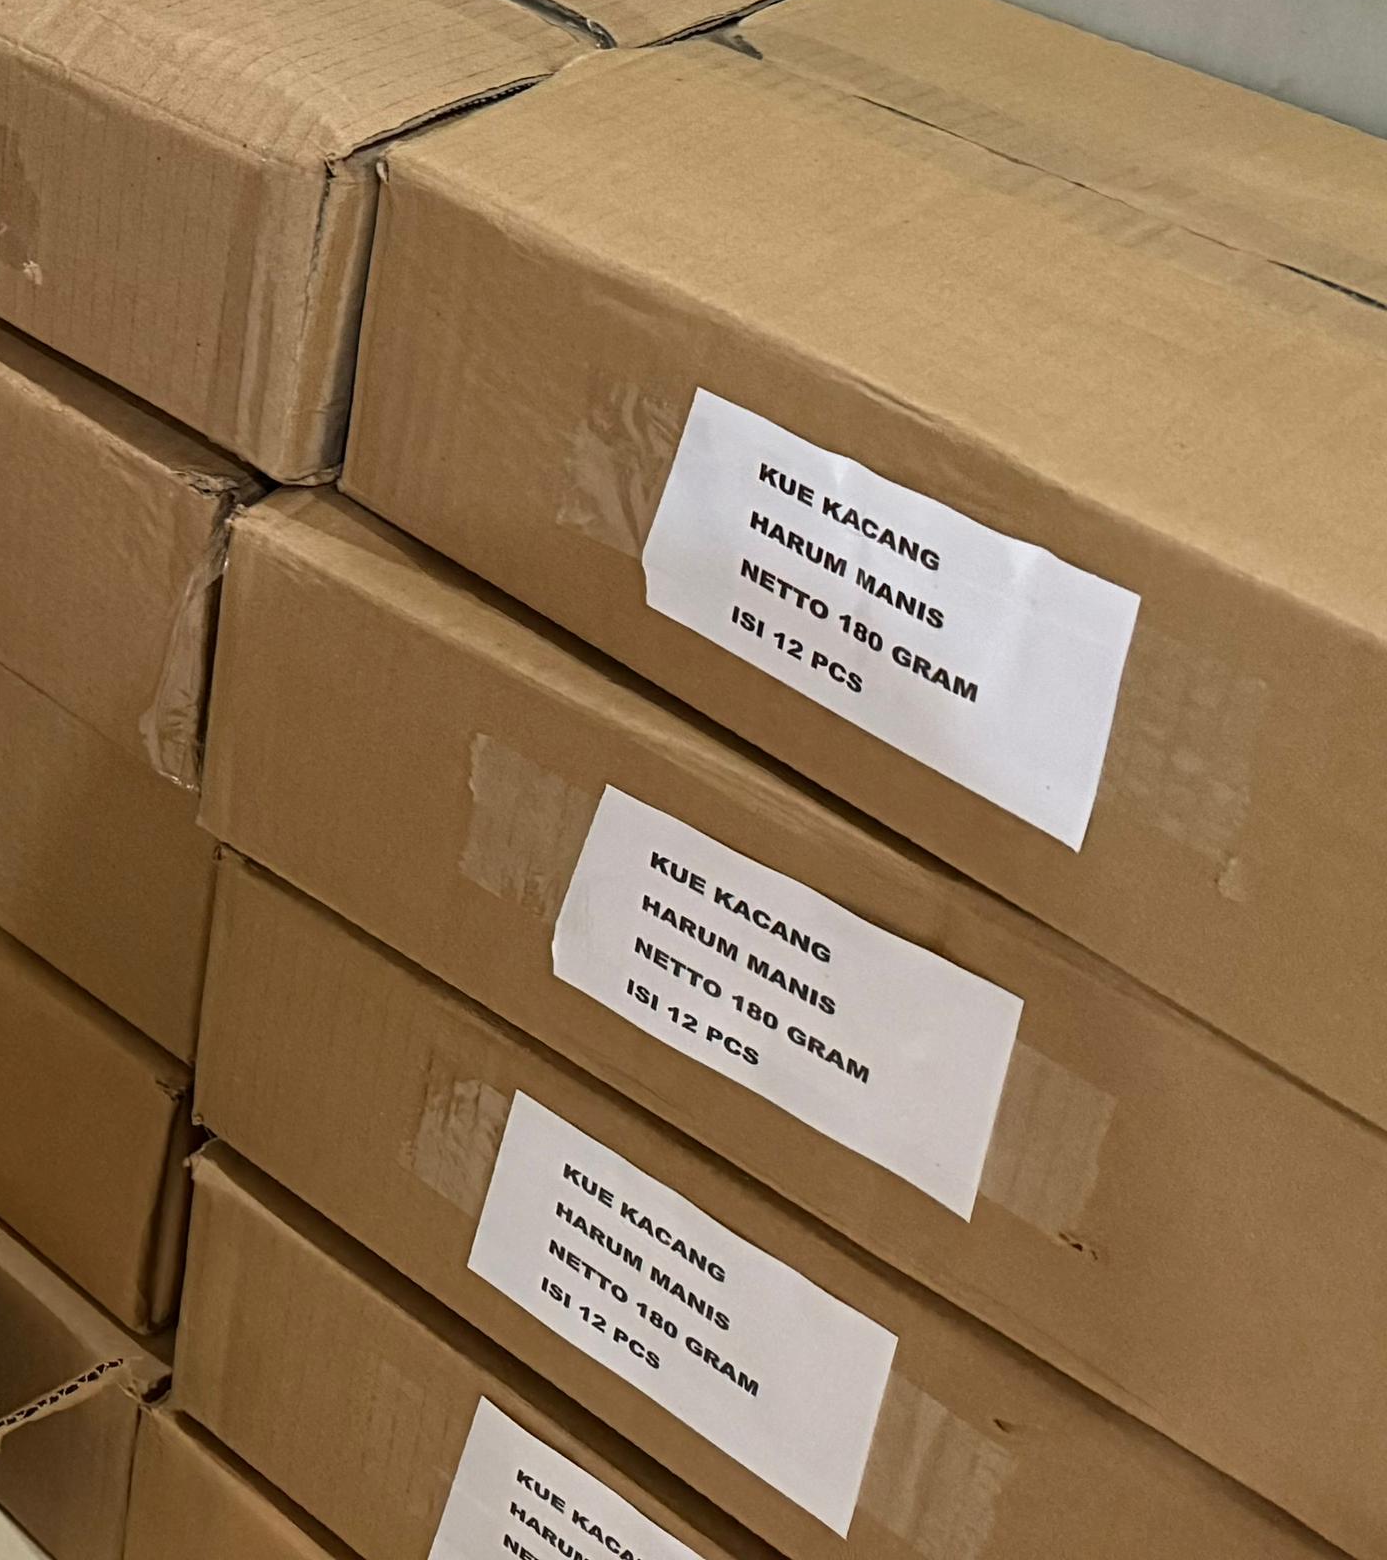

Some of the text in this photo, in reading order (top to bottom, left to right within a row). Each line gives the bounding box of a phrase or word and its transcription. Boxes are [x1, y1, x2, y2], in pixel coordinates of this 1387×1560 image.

[750, 511, 944, 630] HARUM MANIS
[759, 464, 940, 572] KUE KACANG
[731, 606, 863, 694] ISI 12 PCS
[740, 559, 978, 703] NETTO 180 GRAM
[641, 895, 836, 1015] HARUM MANIS
[650, 852, 831, 963] KUE KACANG
[626, 979, 761, 1066] ISI 12 PCS
[634, 937, 871, 1083] NETTO 180 GRAM
[555, 1202, 730, 1331] HARUM MANIS
[563, 1164, 726, 1283] KUE KACANG
[540, 1277, 660, 1370] ISI 12 PCS
[548, 1240, 759, 1397] NETTO 180 GRAM
[516, 1469, 566, 1514] KUE
[572, 1509, 642, 1560] KACA
